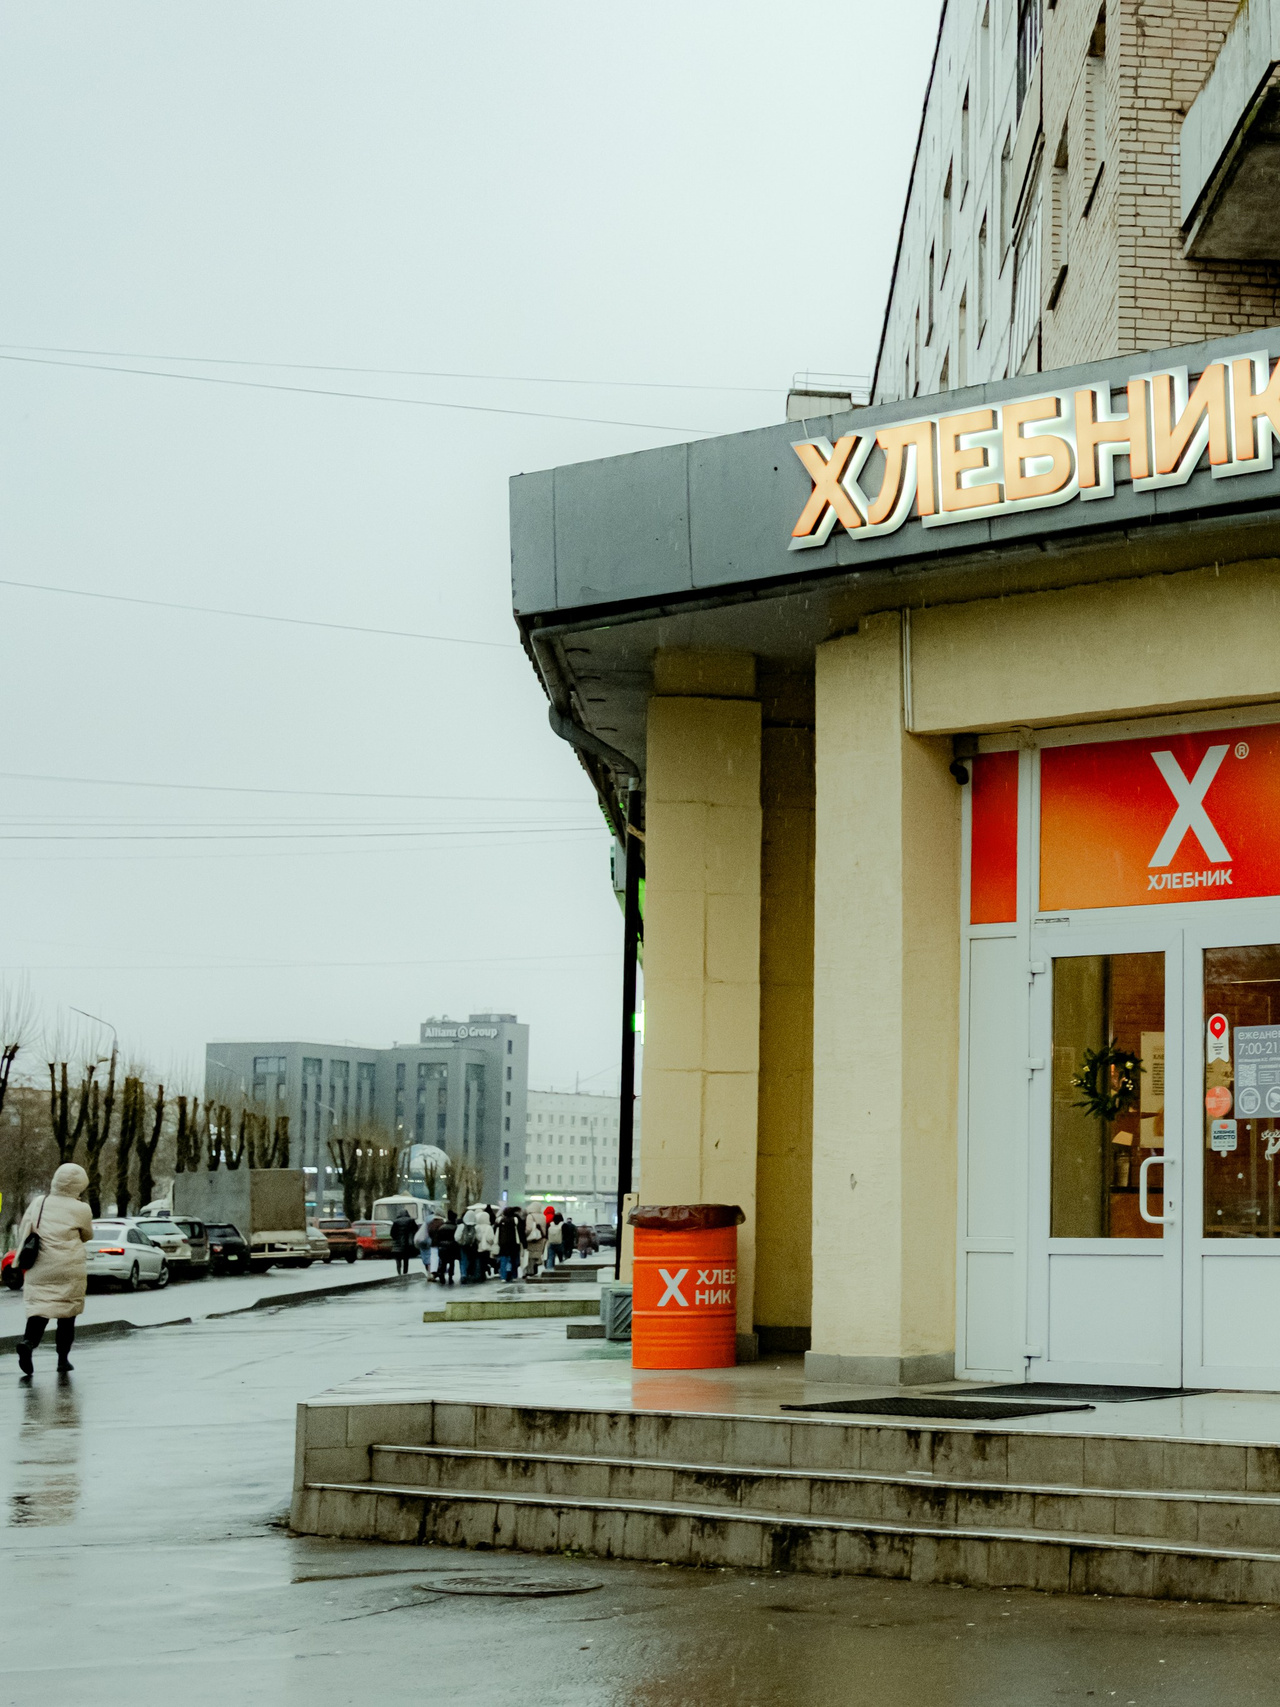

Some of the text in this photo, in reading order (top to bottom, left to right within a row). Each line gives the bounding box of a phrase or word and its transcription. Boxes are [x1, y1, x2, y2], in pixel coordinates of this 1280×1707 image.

[1147, 869, 1233, 890] ХЛЕБНИК
[425, 1027, 498, 1039] Allianz Group
[695, 1290, 731, 1305] НИК
